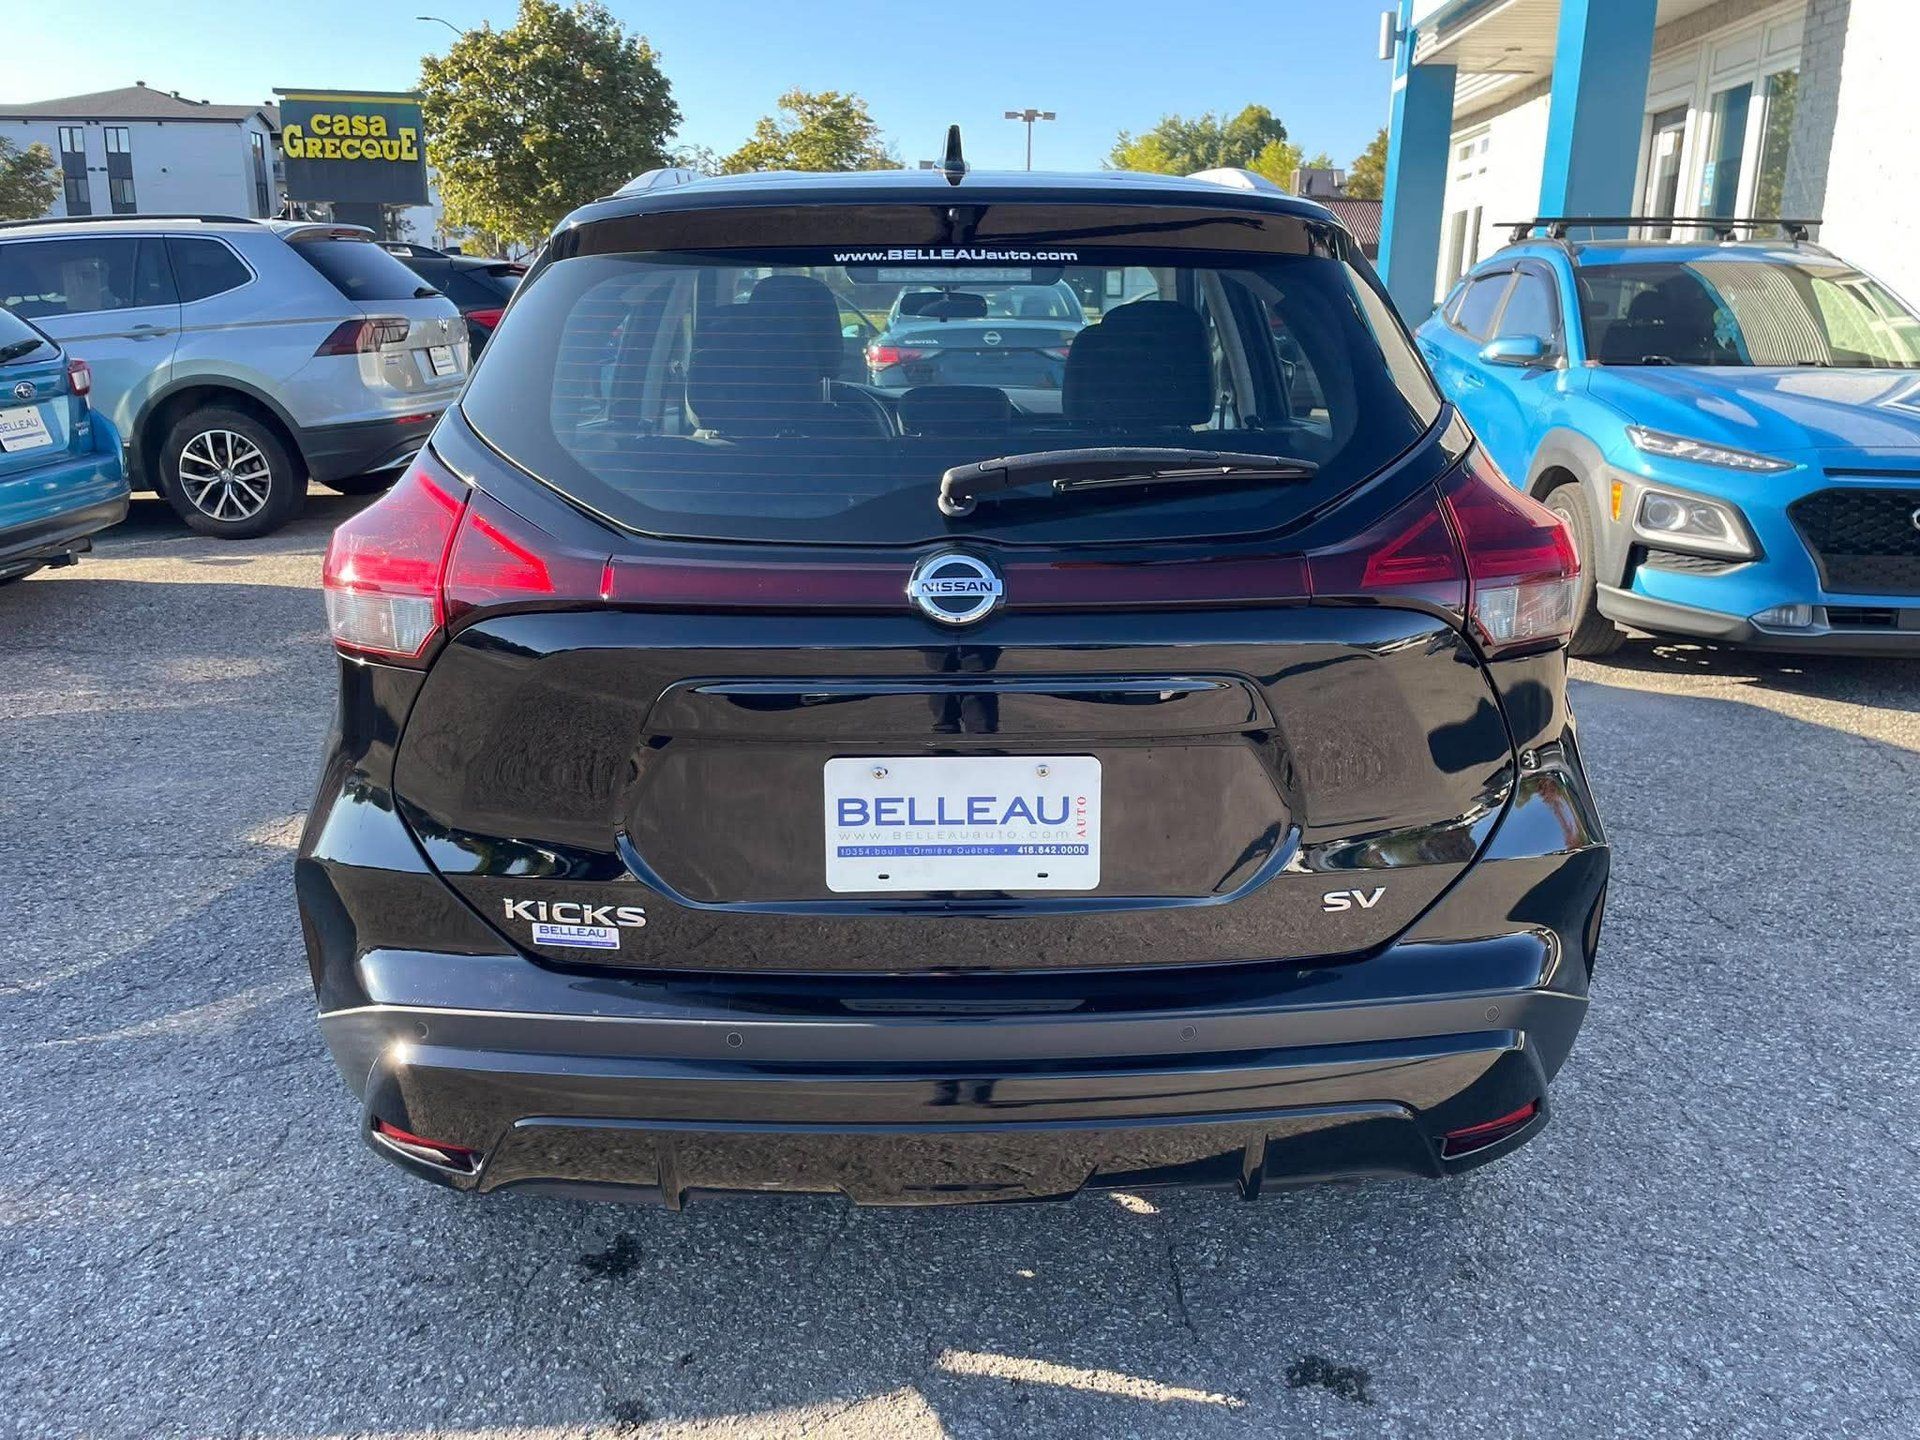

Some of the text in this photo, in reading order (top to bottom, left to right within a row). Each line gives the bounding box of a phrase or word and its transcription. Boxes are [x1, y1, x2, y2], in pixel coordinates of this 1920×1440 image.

[283, 124, 418, 161] GRECQUE
[833, 249, 1078, 262] www.BELLEAUauto.com
[921, 581, 993, 593] NISSAN
[837, 796, 1070, 827] BELLEAU
[1076, 796, 1087, 838] AUTO
[1017, 845, 1087, 855] 418.842.0000
[1322, 886, 1387, 912] SV
[539, 925, 608, 938] BELLEAU
